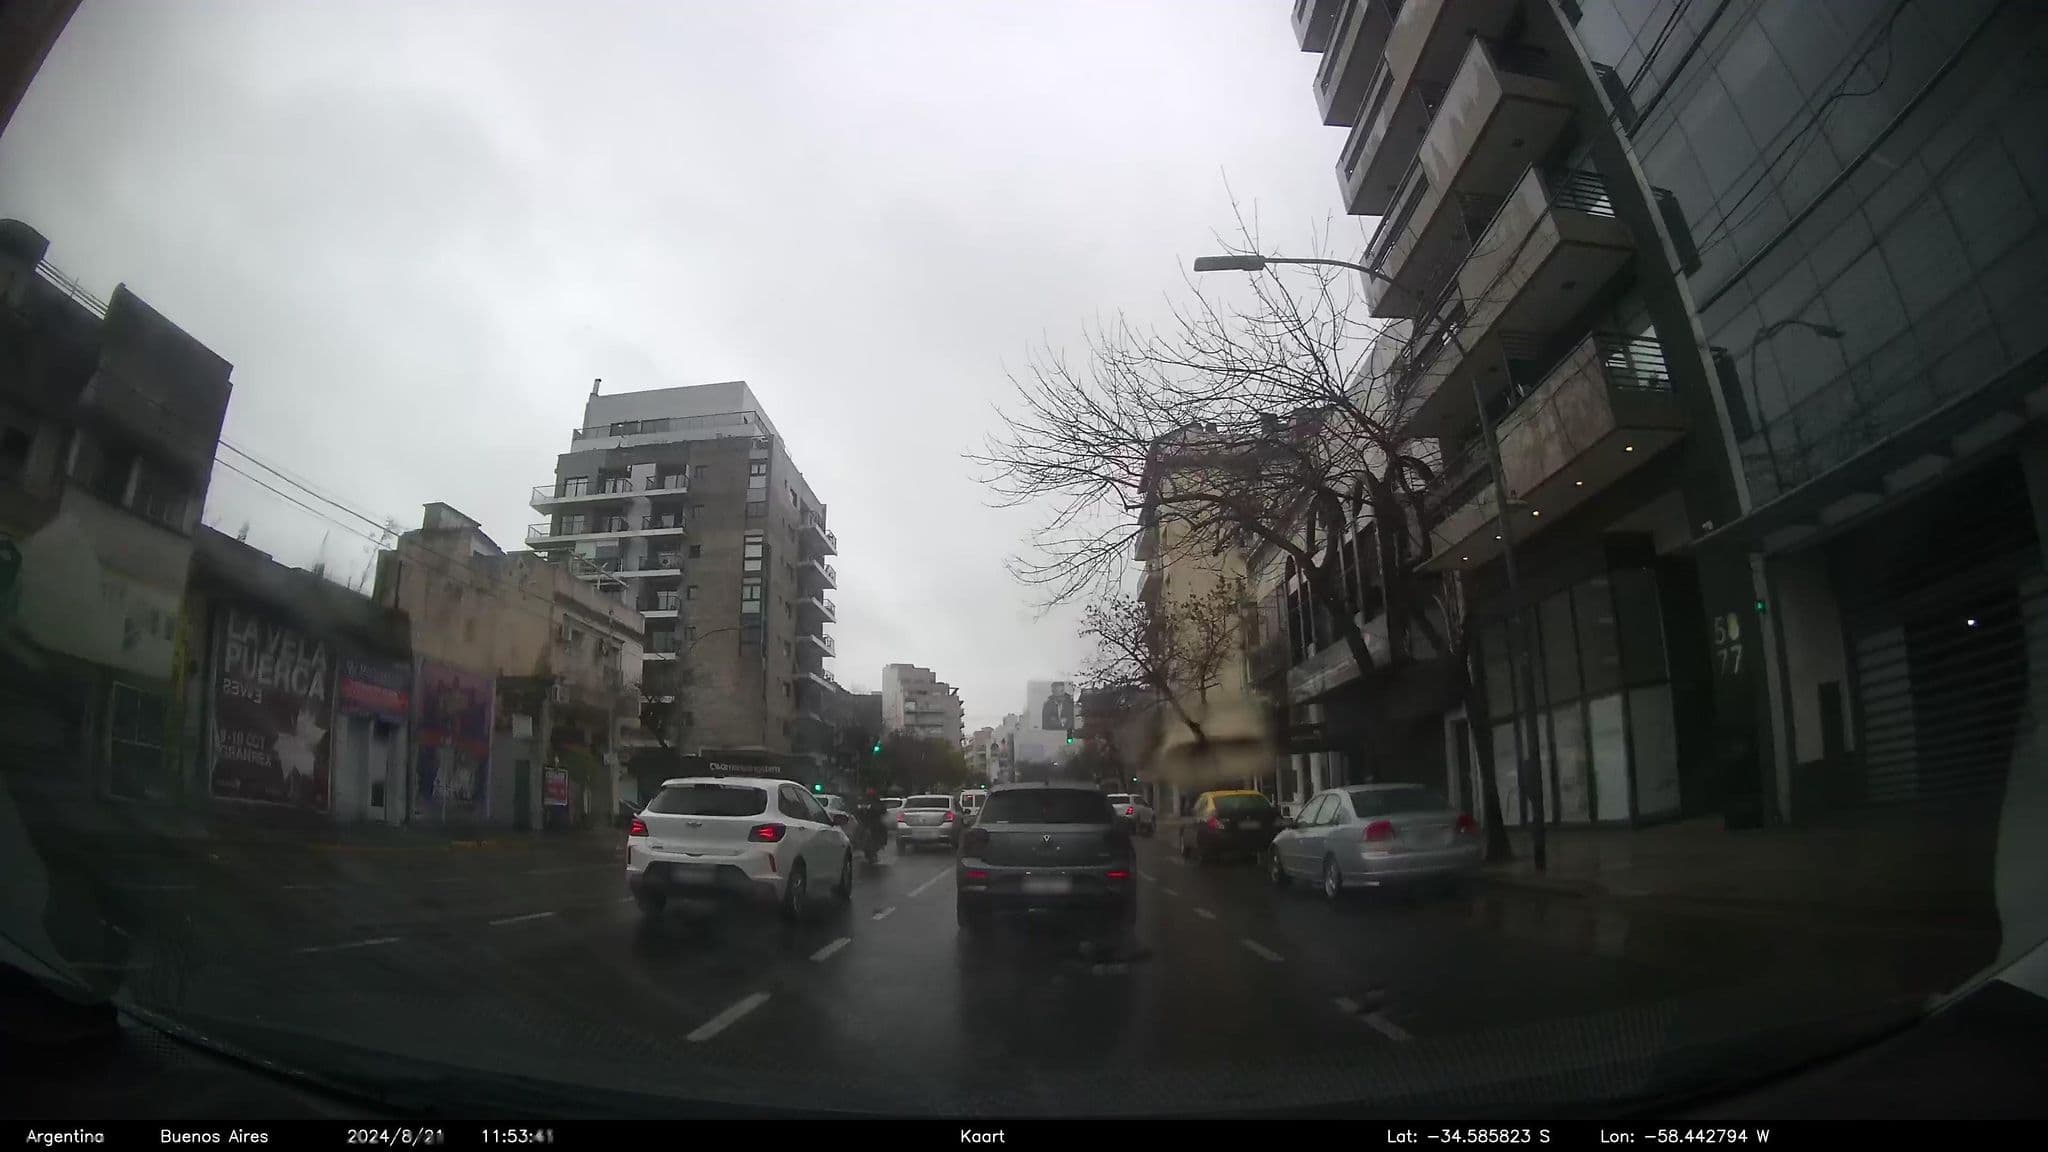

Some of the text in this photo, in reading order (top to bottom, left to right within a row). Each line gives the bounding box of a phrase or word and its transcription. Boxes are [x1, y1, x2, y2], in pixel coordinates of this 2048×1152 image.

[227, 608, 260, 645] LA
[265, 623, 327, 672] VELA
[224, 642, 325, 702] PUERCA
